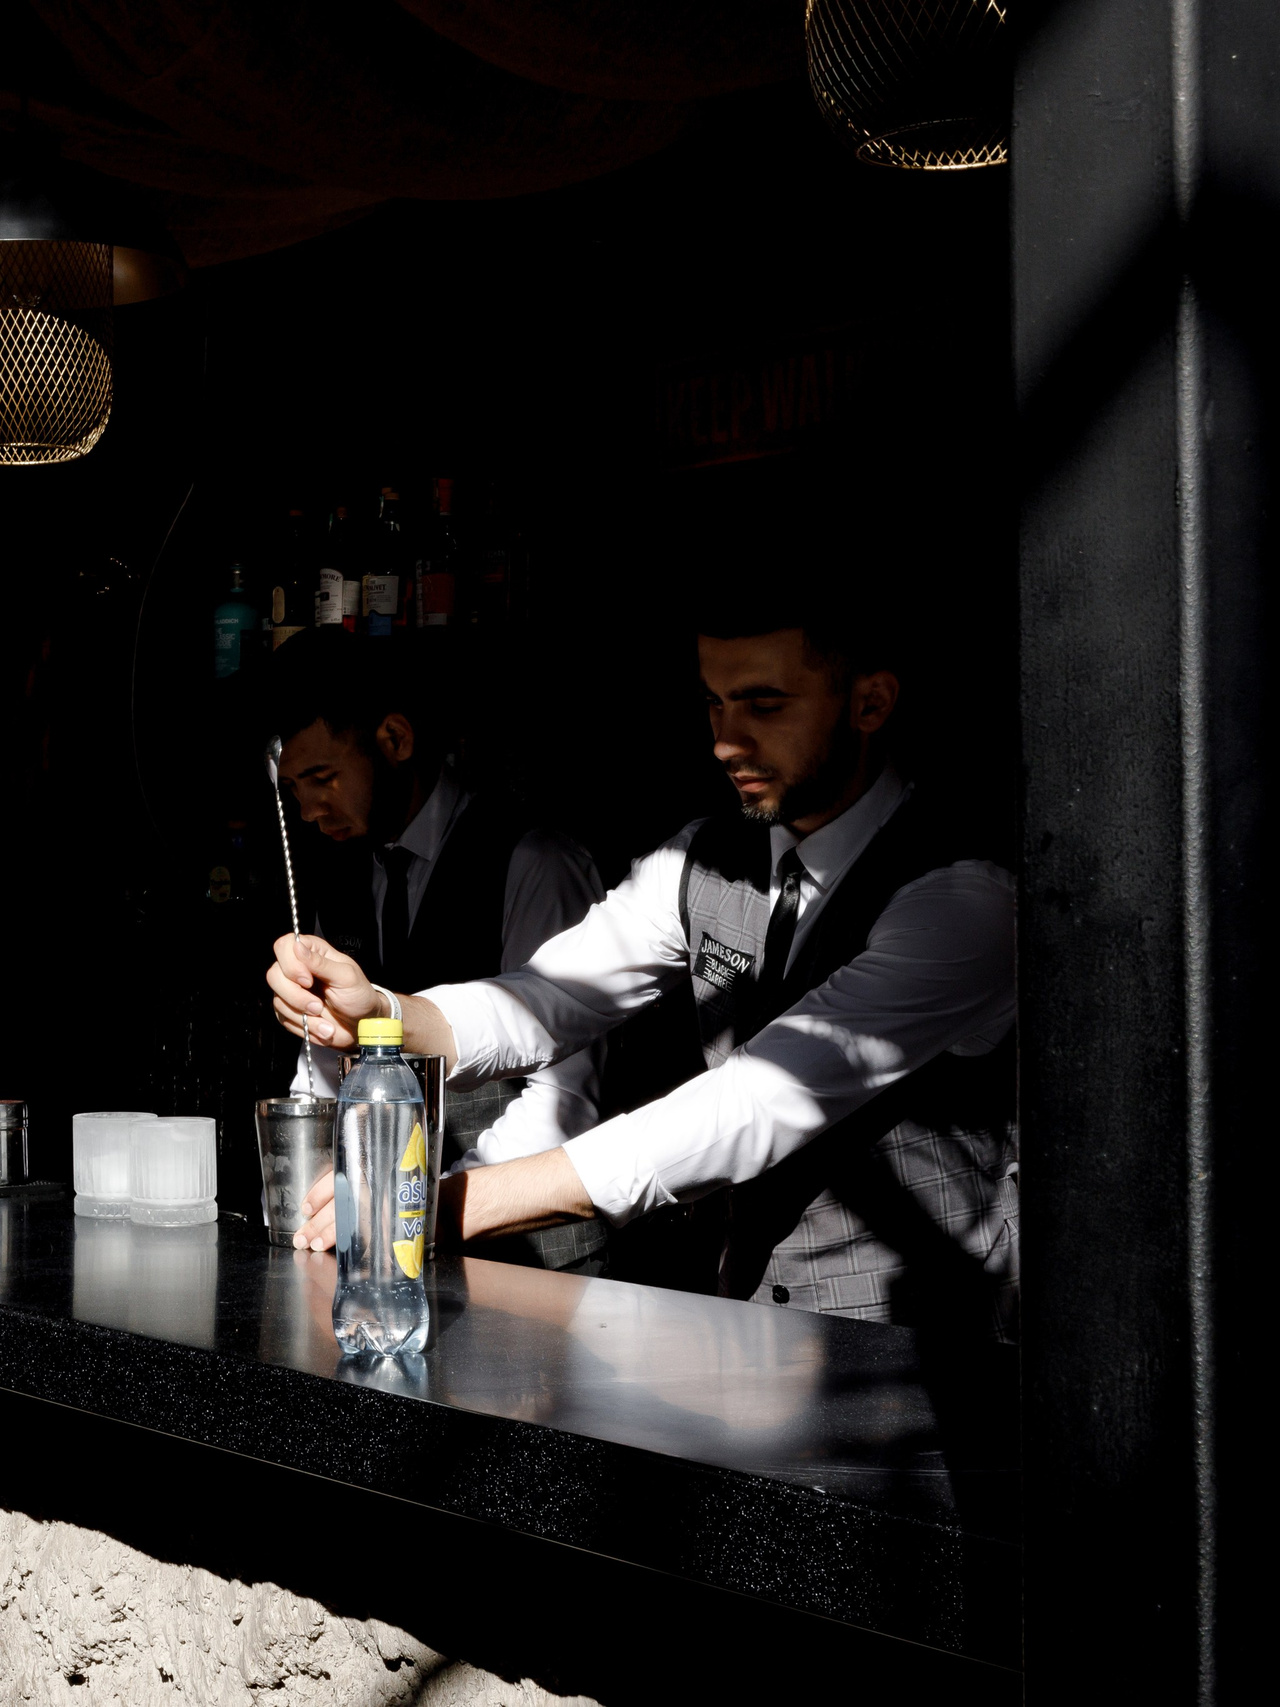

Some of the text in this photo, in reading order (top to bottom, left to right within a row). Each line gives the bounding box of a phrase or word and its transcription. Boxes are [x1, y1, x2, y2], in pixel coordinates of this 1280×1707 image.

[665, 370, 753, 448] KEEP
[321, 572, 340, 583] MORE
[701, 938, 750, 974] JAMESON
[710, 958, 729, 978] BLACK
[402, 1218, 425, 1238] vo
